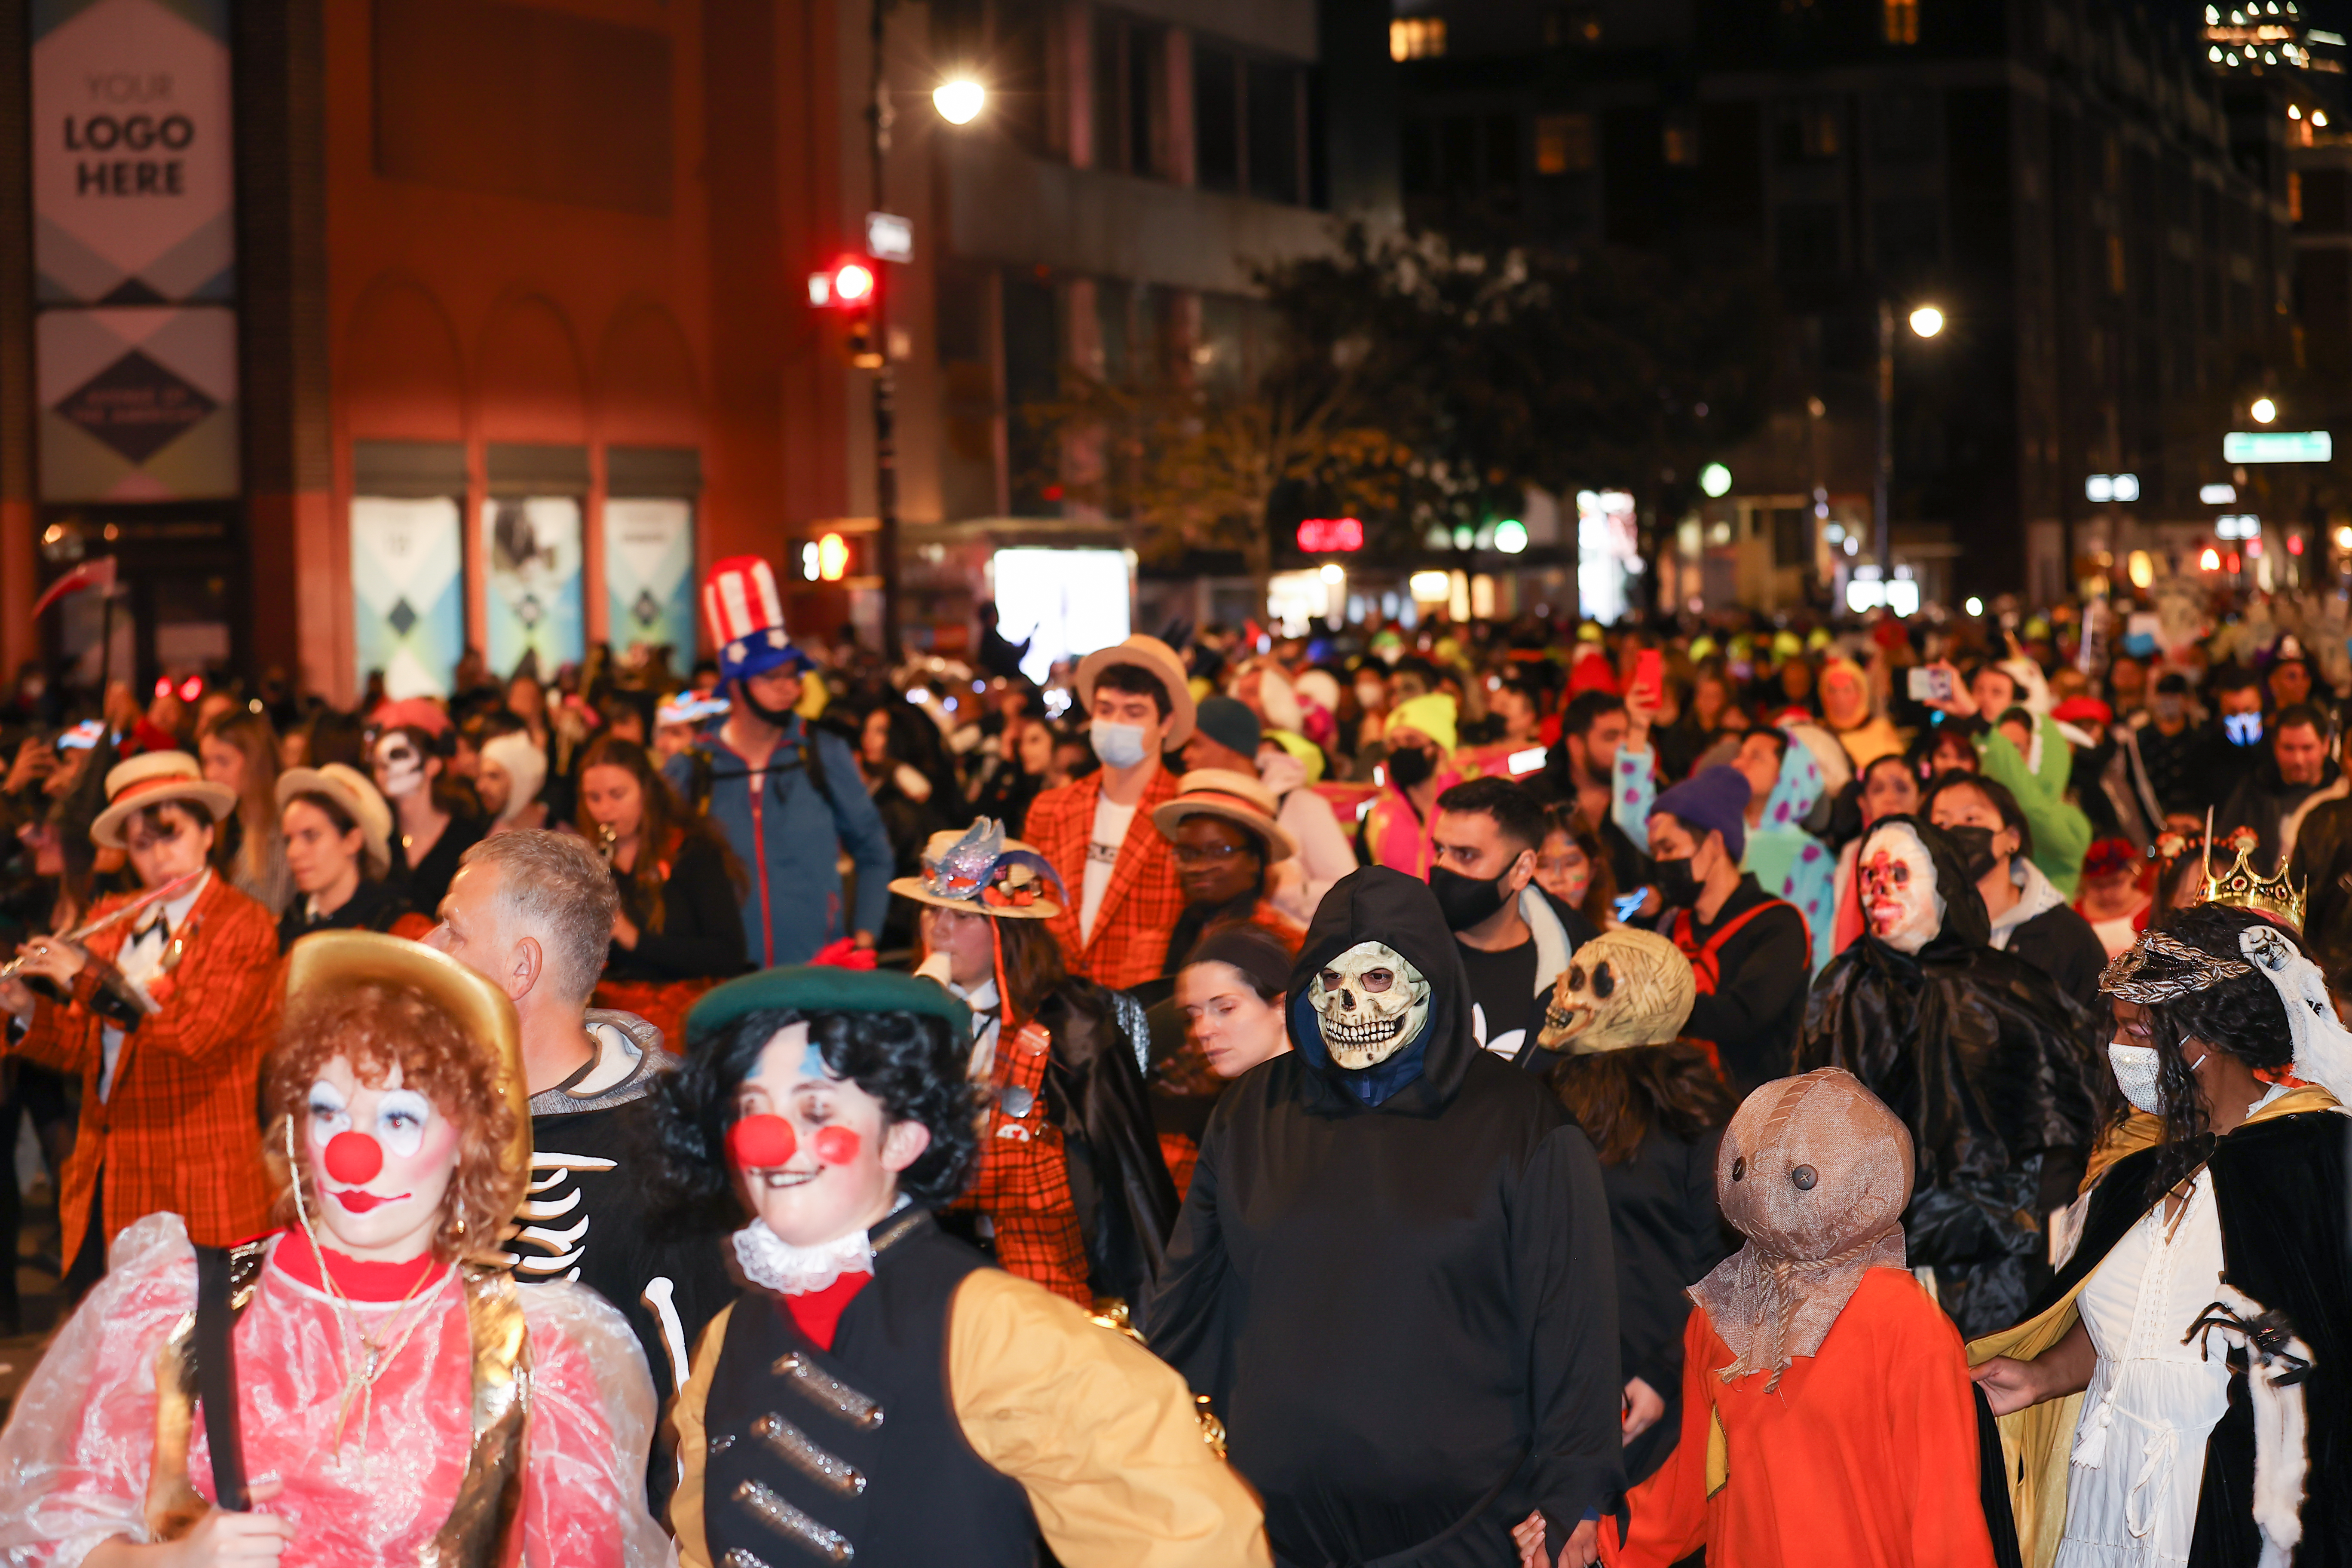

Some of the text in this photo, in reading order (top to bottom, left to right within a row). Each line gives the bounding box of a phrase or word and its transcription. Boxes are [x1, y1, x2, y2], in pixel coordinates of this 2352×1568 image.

[86, 74, 171, 102] YOUR
[64, 113, 195, 152] LOGO
[76, 159, 183, 197] HERE
